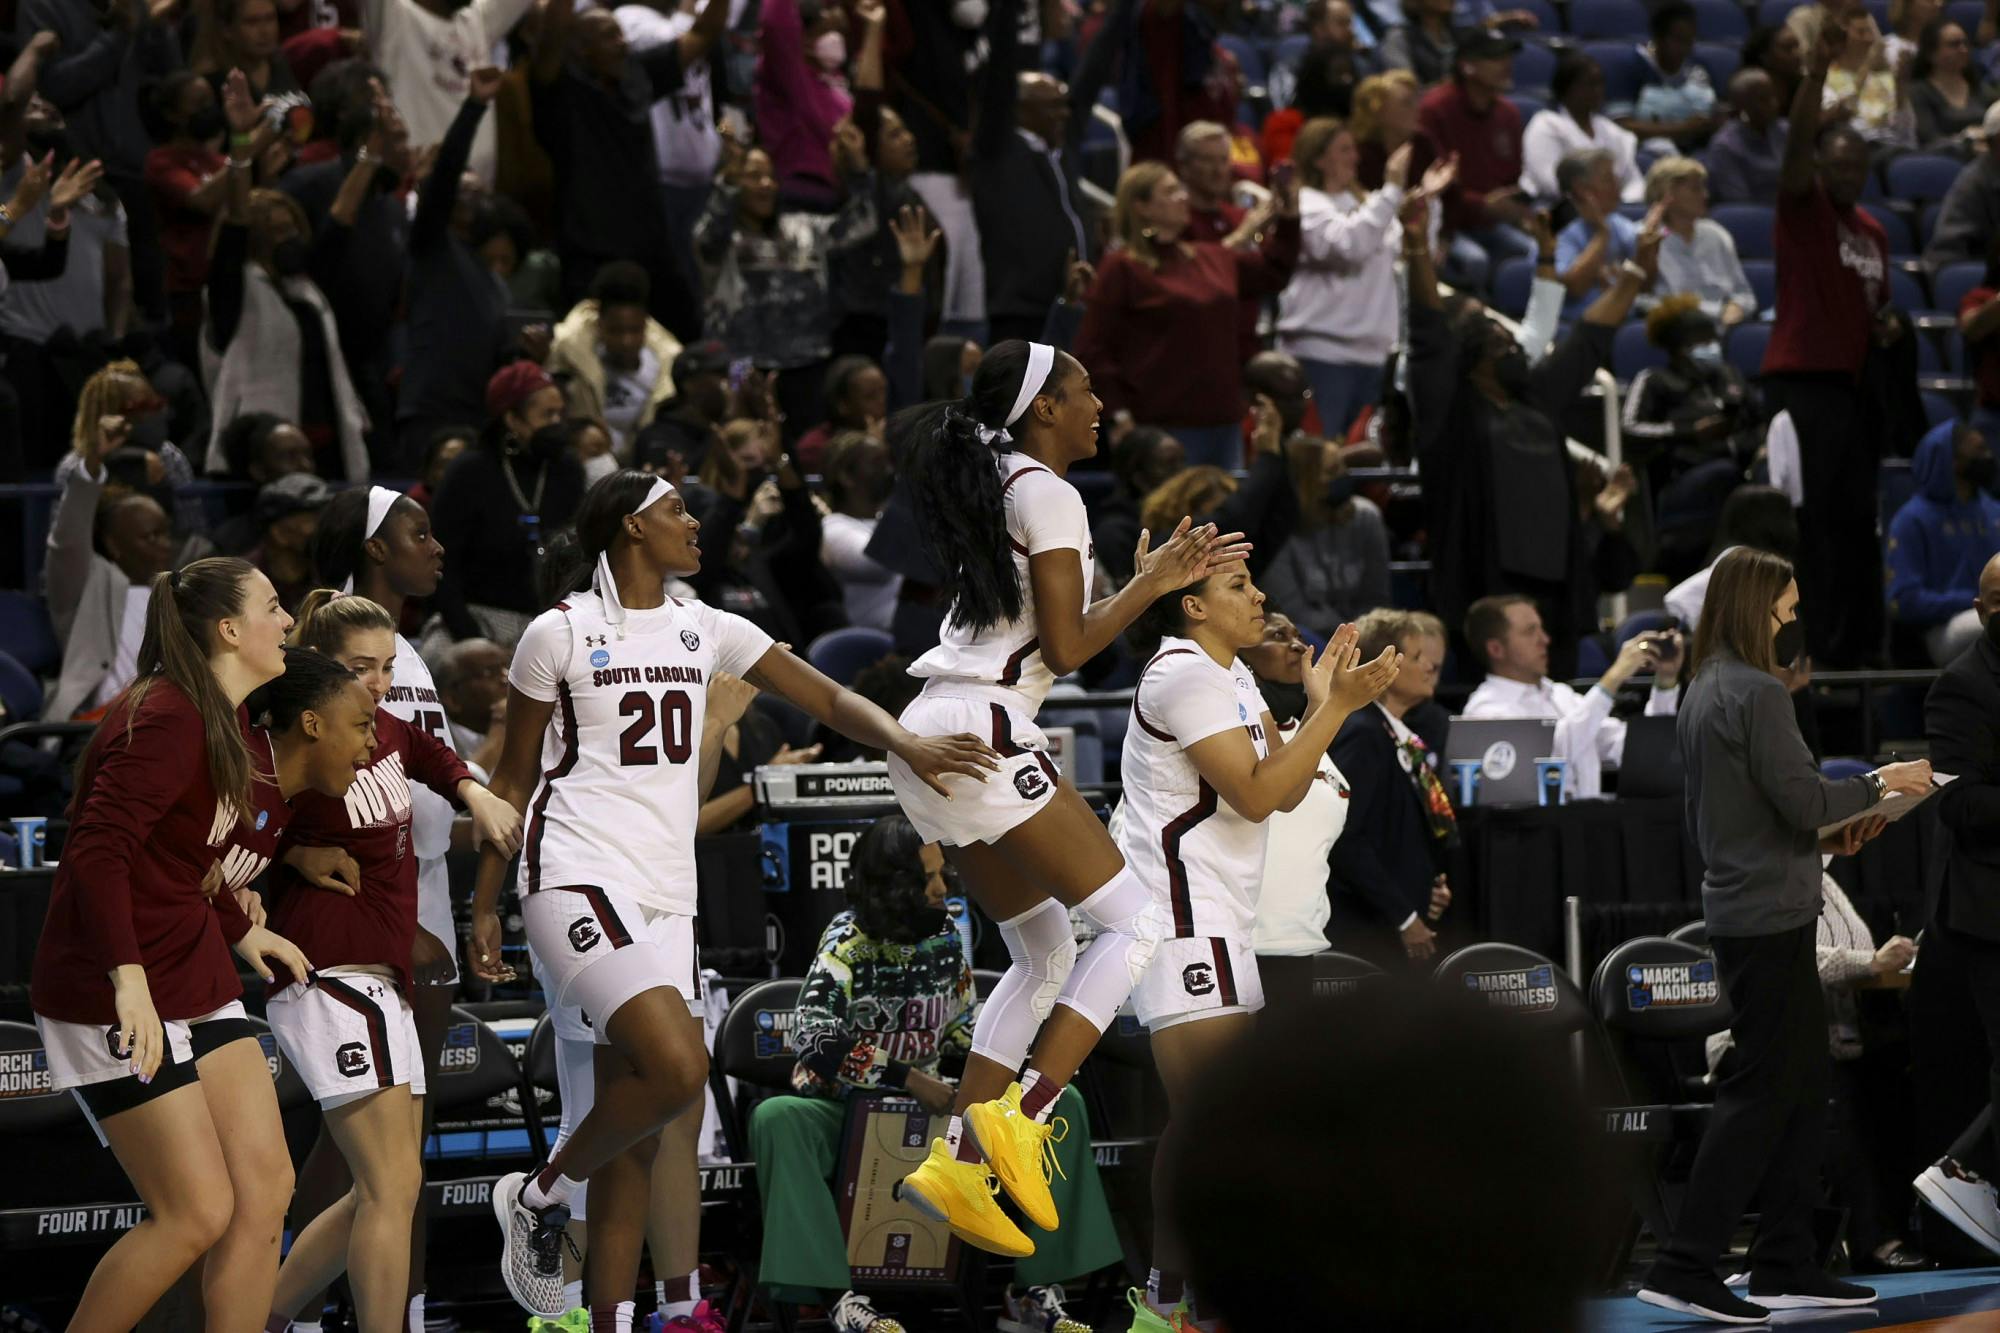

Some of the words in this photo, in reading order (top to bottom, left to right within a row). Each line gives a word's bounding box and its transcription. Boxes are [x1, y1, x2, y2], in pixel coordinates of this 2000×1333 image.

[593, 667, 641, 687] SOUTH
[644, 666, 703, 686] CAROLINA
[385, 686, 415, 703] SOUTH
[619, 690, 692, 766] 20
[825, 777, 895, 792] POWERA
[344, 768, 387, 829] NO
[1479, 973, 1527, 991] MARCH
[1642, 967, 1689, 984] MARCH
[1652, 982, 1717, 1001] MADNESS
[0, 1053, 32, 1073] RCH
[1623, 1111, 1648, 1131] ALL
[713, 1168, 743, 1190] ALL
[442, 1182, 490, 1206] FOUR
[38, 1210, 87, 1235] FOUR
[92, 1208, 111, 1231] IT
